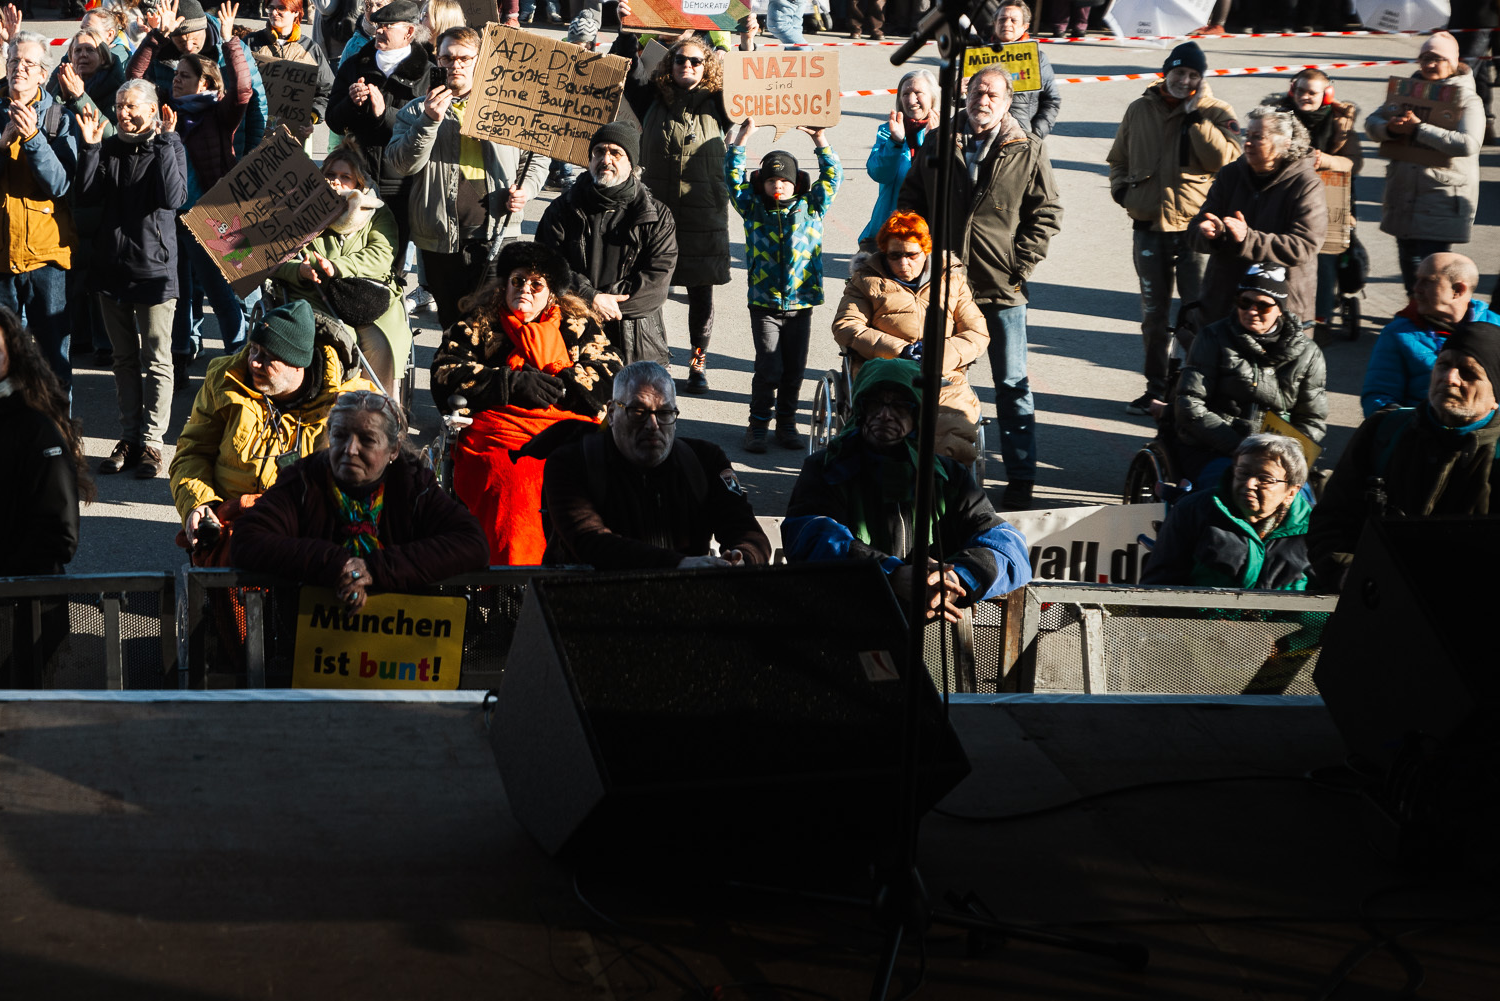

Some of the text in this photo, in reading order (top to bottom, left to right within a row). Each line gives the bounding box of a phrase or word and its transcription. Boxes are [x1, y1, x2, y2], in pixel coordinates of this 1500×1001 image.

[467, 4, 482, 15] die
[683, 0, 729, 10] DEMOKRATIE
[547, 50, 590, 76] Die
[742, 56, 825, 80] NAZIS
[968, 49, 1032, 67] München
[282, 67, 318, 87] MEENE
[485, 65, 619, 102] größte Baustelle
[765, 80, 794, 91] sind
[273, 103, 306, 122] MUSS
[730, 89, 832, 117] SCHEISSIG!
[478, 105, 525, 127] Gegen
[476, 121, 510, 137] Gegen
[243, 170, 298, 228] DIE AFD
[259, 172, 321, 239] IST KEINE
[264, 188, 340, 271] ALTERNATIVE!
[310, 603, 452, 638] München
[314, 646, 442, 682] ist bunt!
